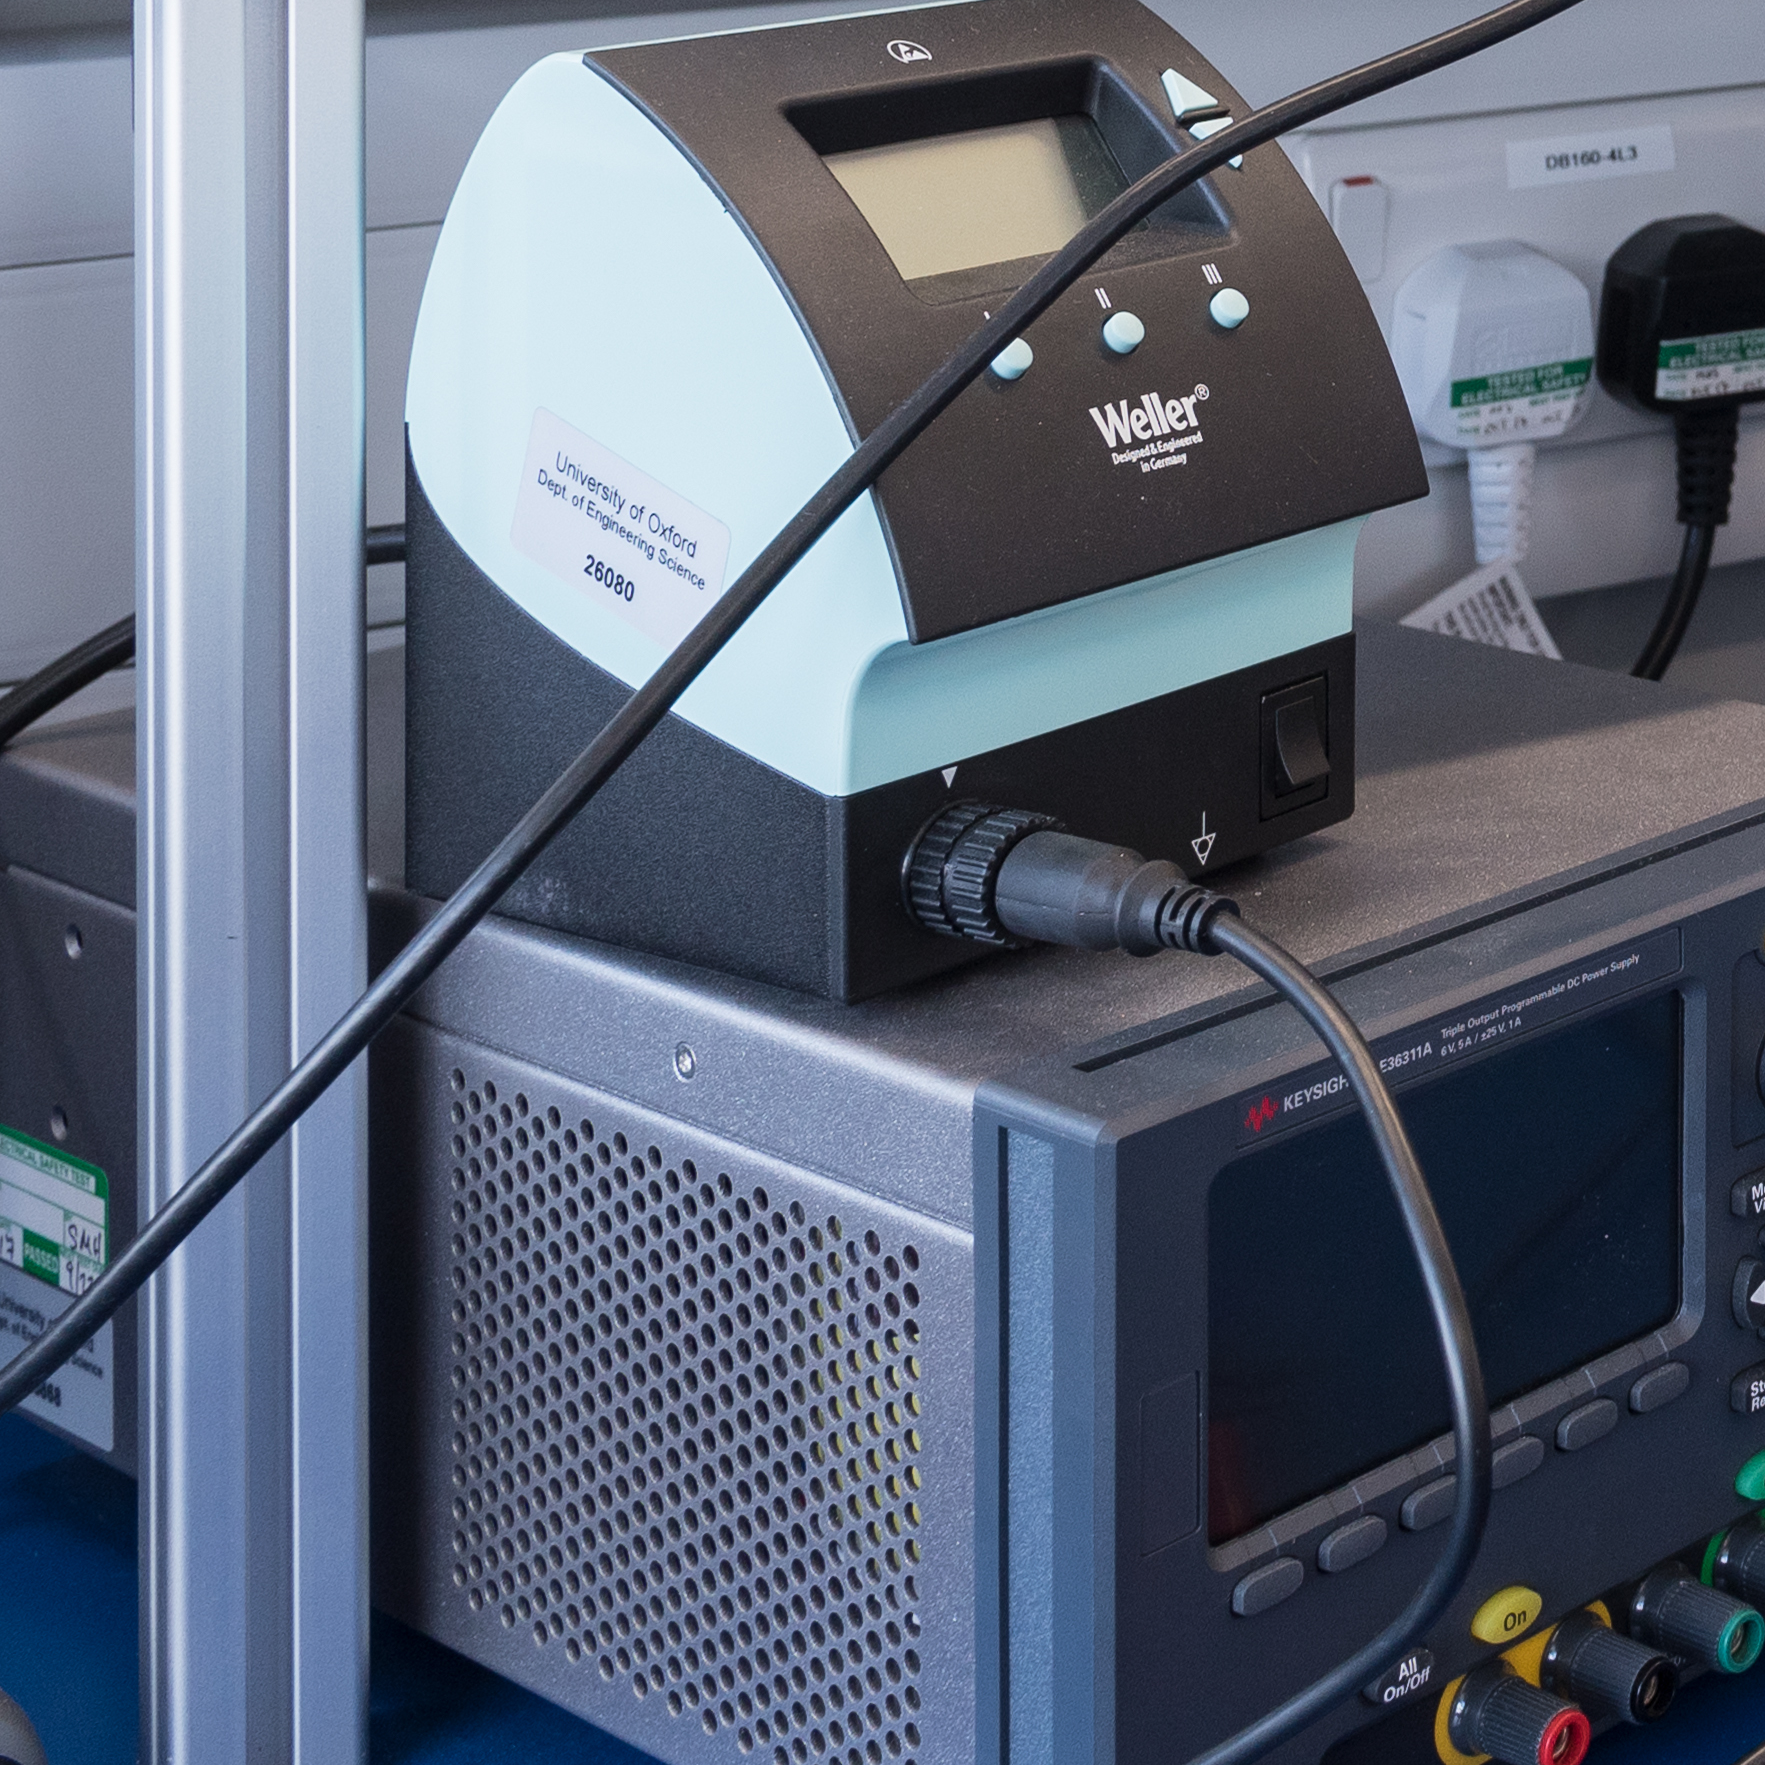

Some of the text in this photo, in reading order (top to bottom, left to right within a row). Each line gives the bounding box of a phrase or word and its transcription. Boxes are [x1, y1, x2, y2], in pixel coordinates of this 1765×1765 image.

[1545, 145, 1638, 171] DB160-4L3
[1669, 350, 1742, 369] ELECTRICAL
[1695, 337, 1740, 354] TESTED
[1460, 372, 1587, 404] ELECTRICAL SAFETY
[1488, 365, 1564, 386] TESTED FOR
[1111, 444, 1151, 465] Designed
[1157, 431, 1204, 453] Engineered
[1140, 453, 1187, 474] in Germany
[556, 451, 698, 559] University of Oxford
[537, 468, 706, 591] Dept. of Engineering Science
[584, 554, 636, 603] 26080
[1441, 953, 1640, 1040] Triple Output Programmable DC Power Supply
[1283, 1041, 1433, 1112] KEYSIGH E36311A
[1503, 1609, 1527, 1632] On
[1383, 1665, 1431, 1704] On/Off
[1398, 1656, 1418, 1682] All
